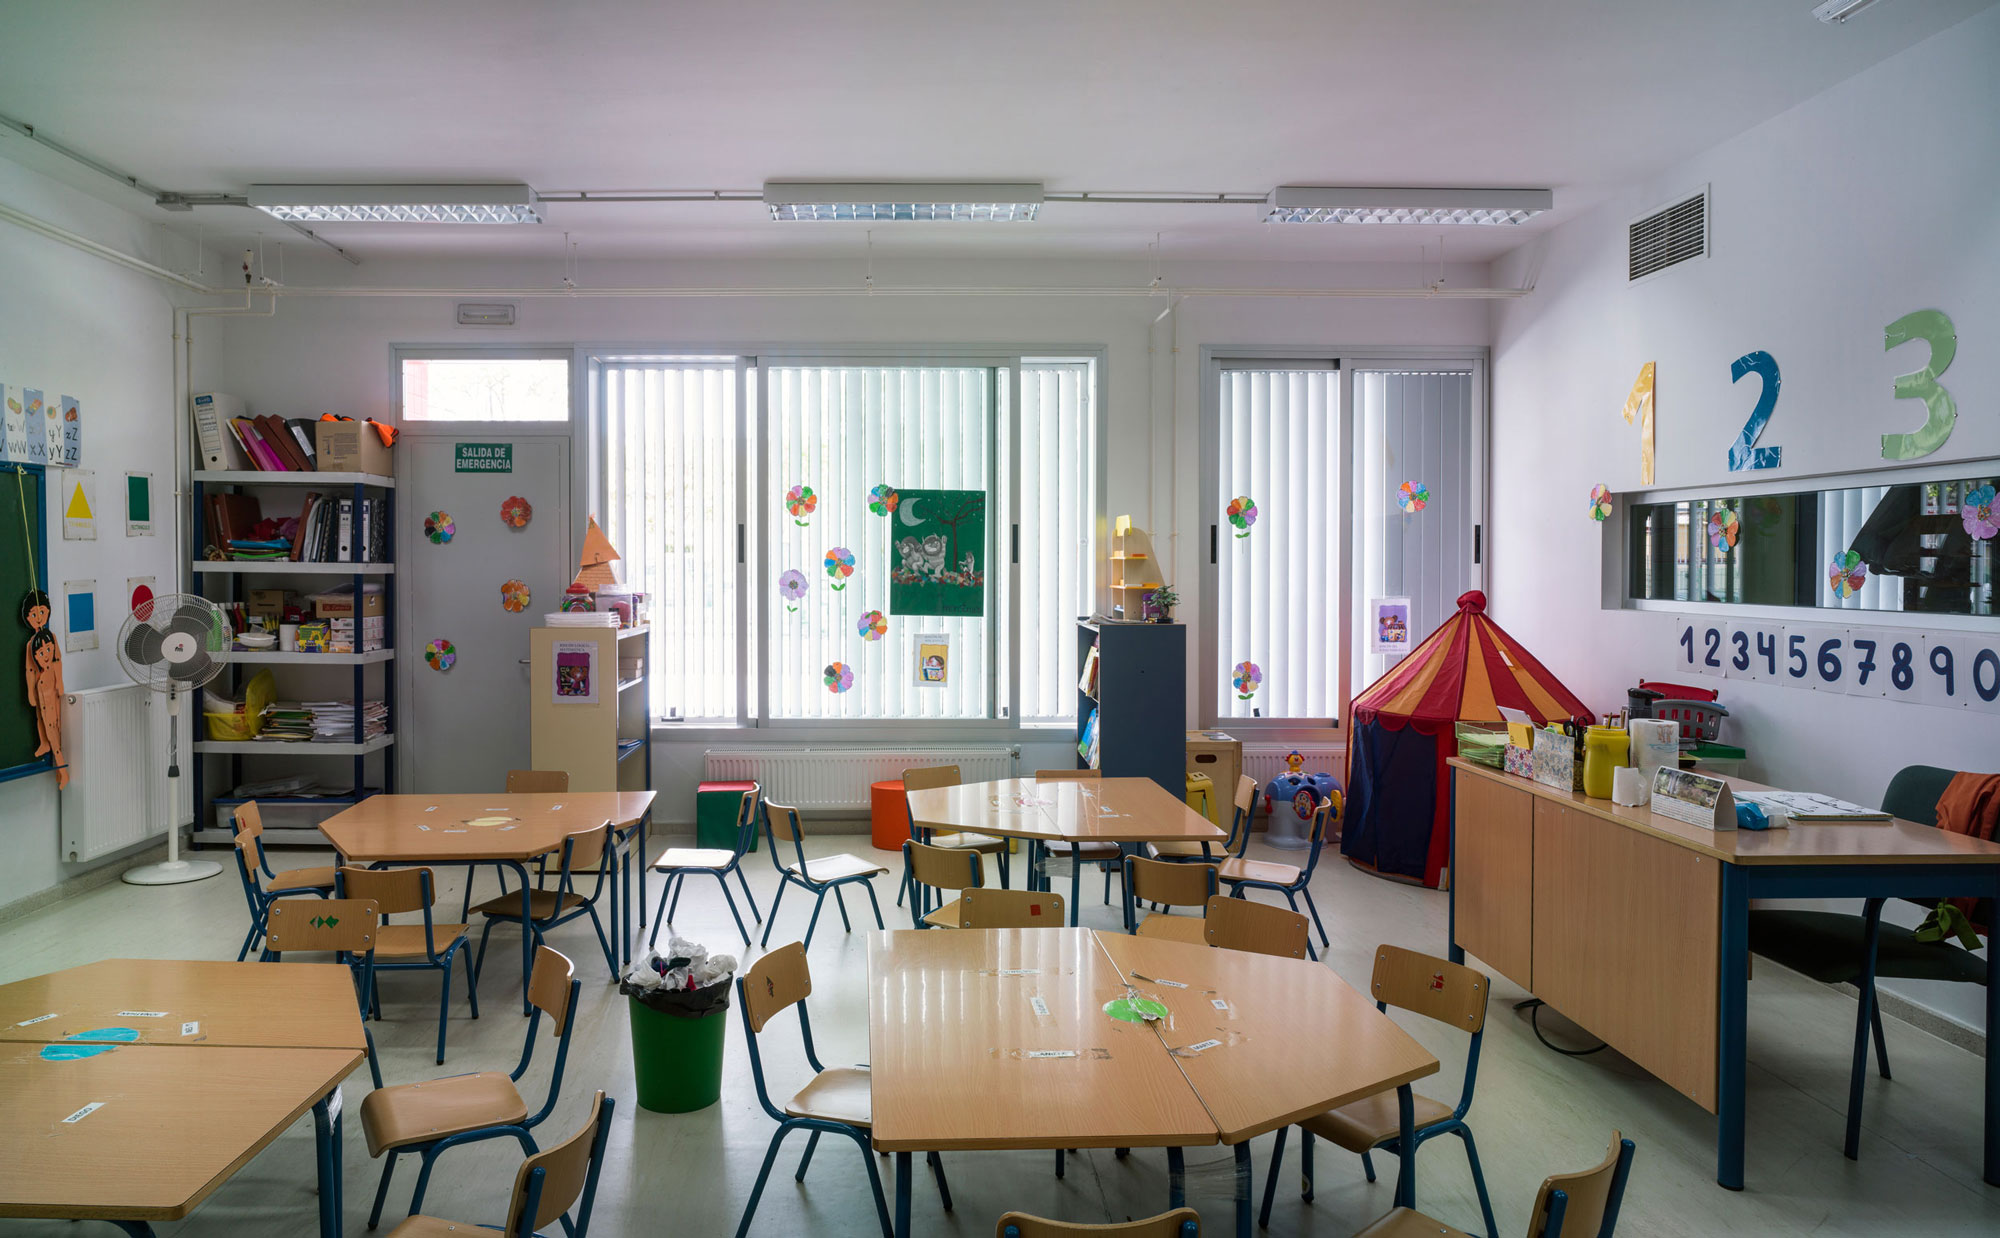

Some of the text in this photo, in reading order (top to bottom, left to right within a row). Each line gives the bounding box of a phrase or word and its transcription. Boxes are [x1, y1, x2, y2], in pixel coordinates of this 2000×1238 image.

[1621, 309, 1957, 486] 1 2 3
[462, 447, 506, 458] SALIDA DE
[456, 458, 511, 469] EMERGENCIA
